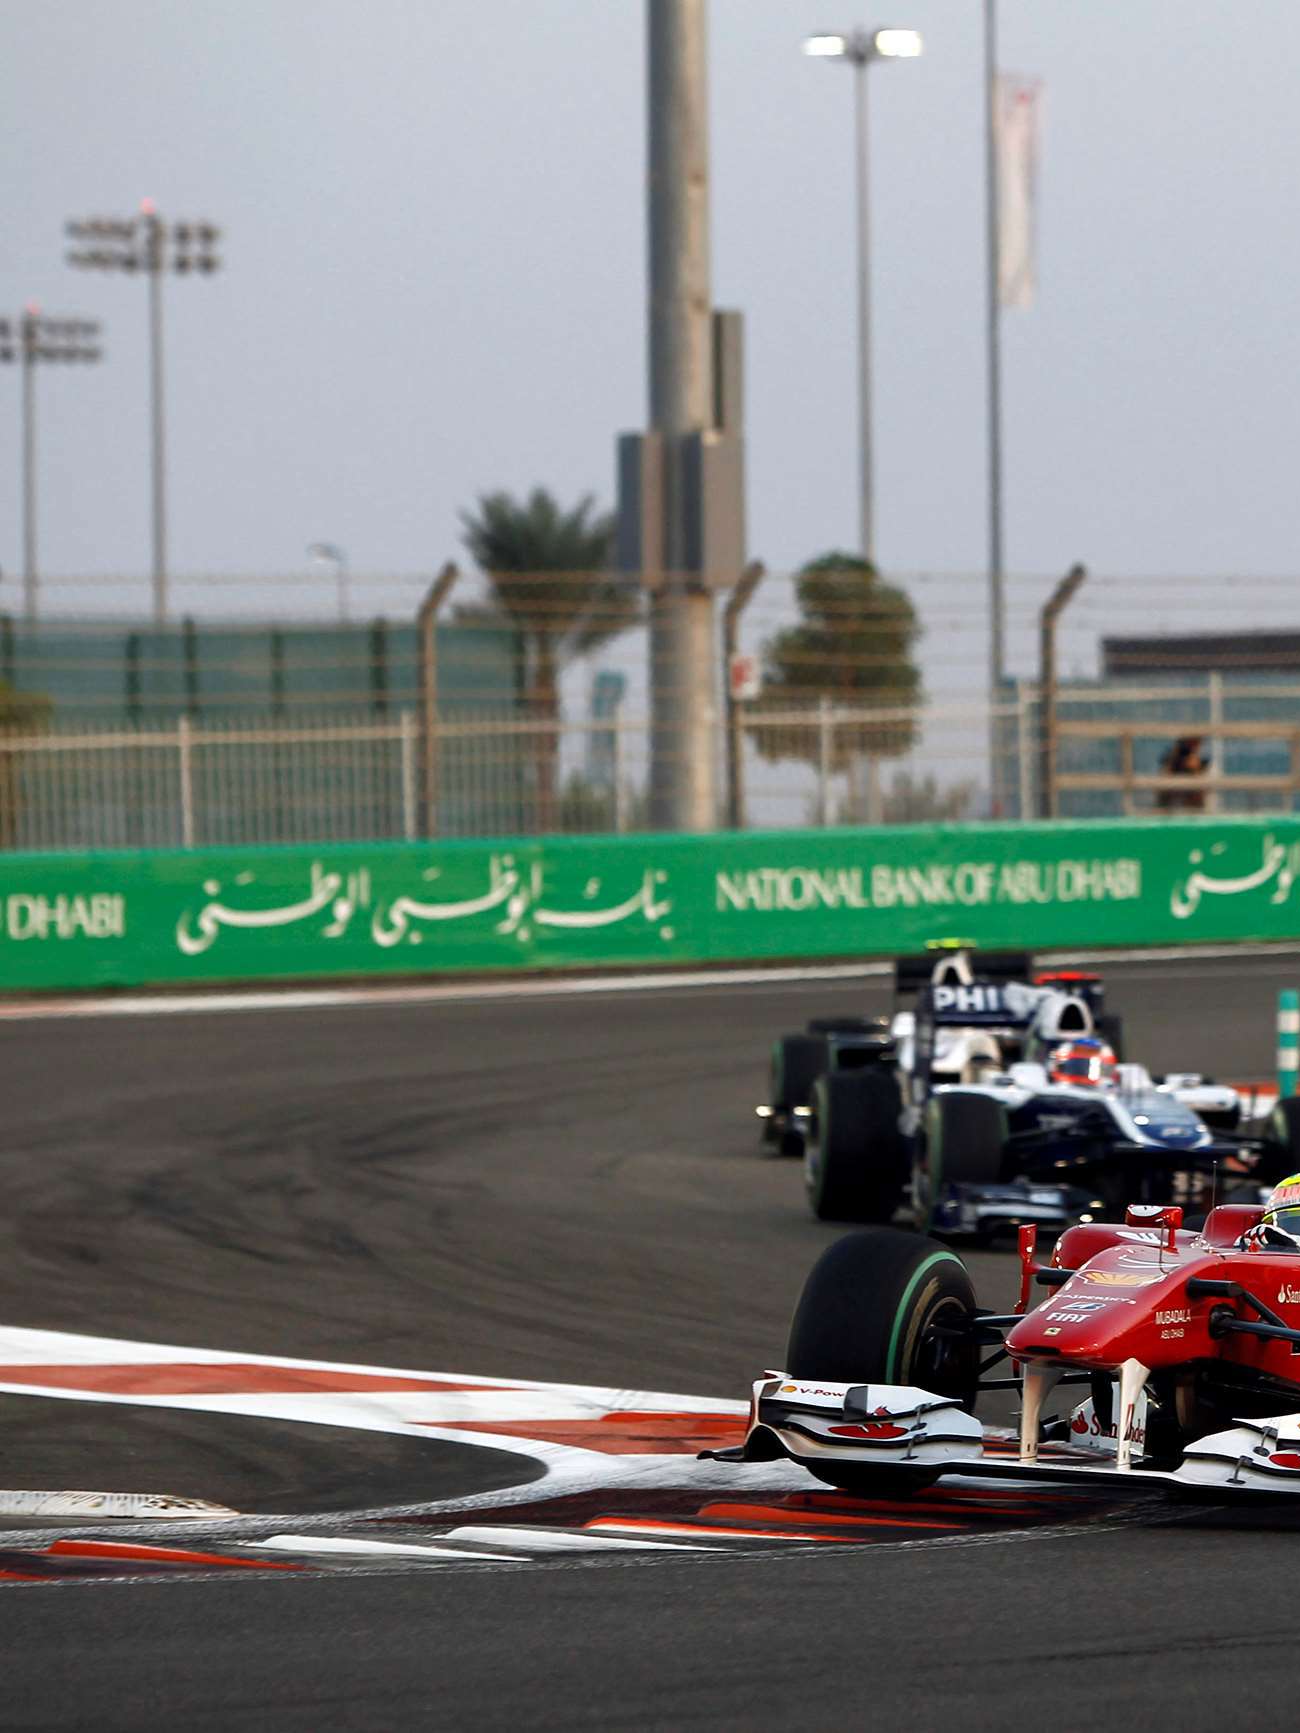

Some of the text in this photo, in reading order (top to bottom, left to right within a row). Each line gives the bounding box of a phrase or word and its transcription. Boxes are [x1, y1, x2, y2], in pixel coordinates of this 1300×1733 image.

[716, 858, 1142, 911] NATIONAL BANK OF ABU DHABI
[7, 893, 125, 940] DHABI
[933, 985, 1000, 1011] PHI
[1045, 1312, 1092, 1323] FIAT
[1155, 1309, 1192, 1325] MUBADALA
[800, 1383, 845, 1397] V-Pow
